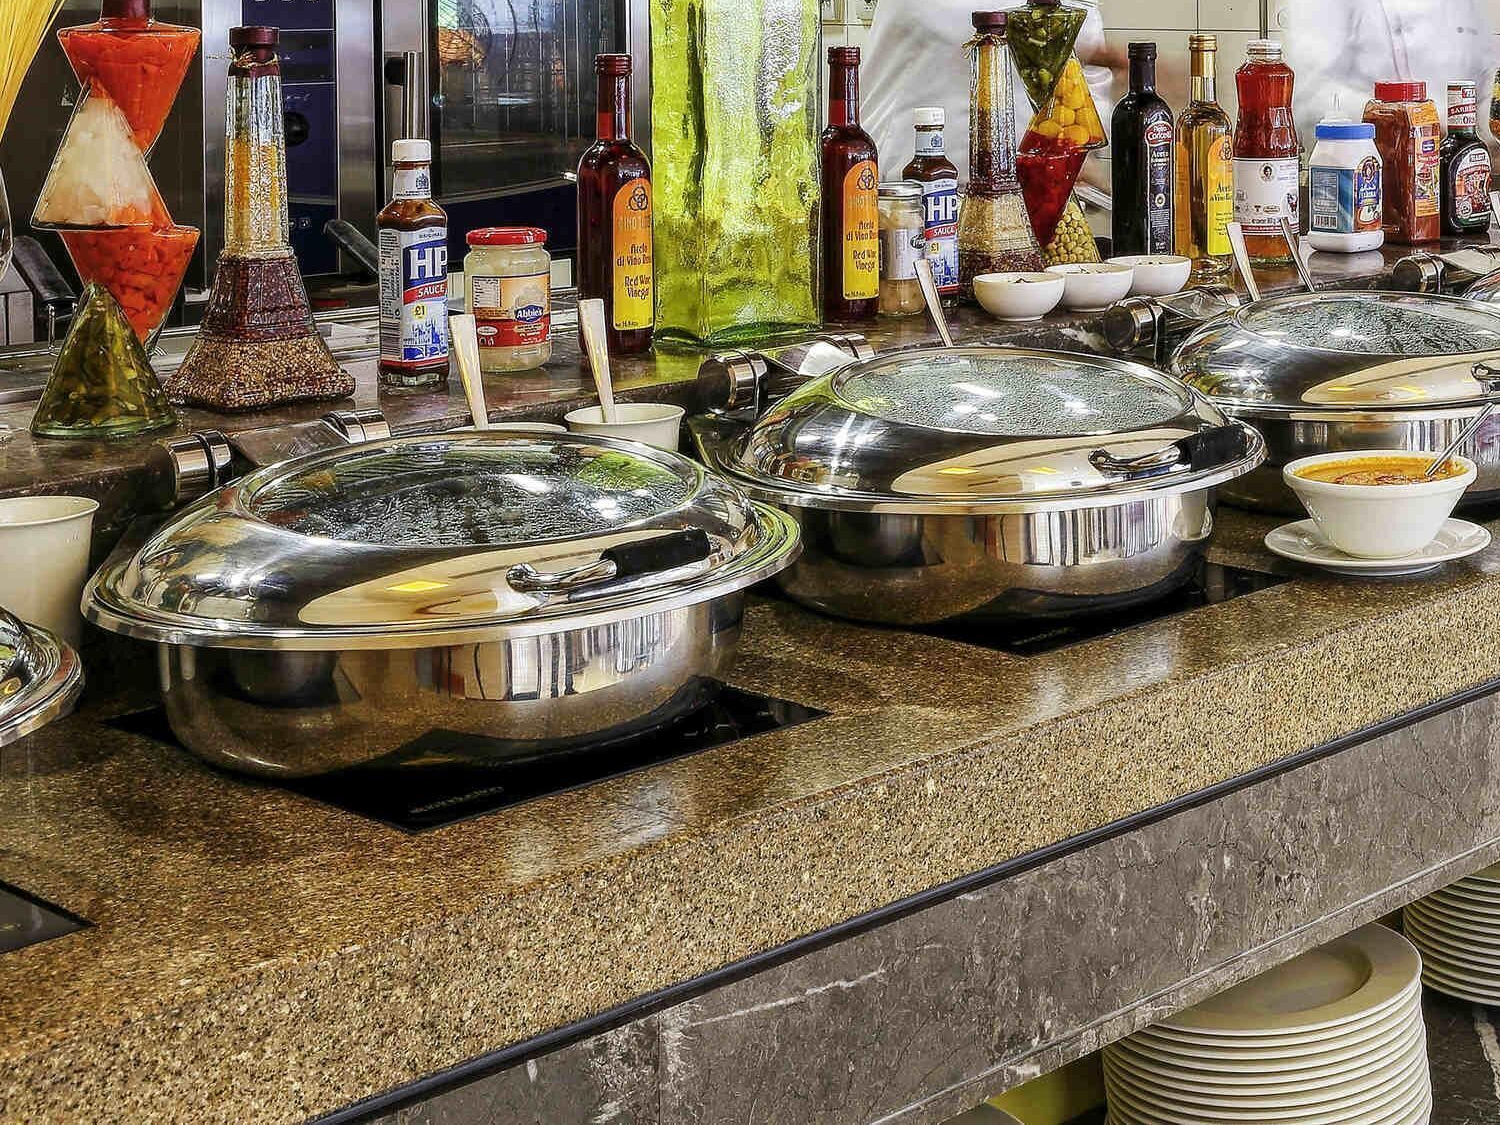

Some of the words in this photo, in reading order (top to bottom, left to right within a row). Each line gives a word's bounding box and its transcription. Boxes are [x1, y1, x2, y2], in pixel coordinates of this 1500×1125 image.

[927, 195, 959, 222] HP
[933, 225, 956, 237] SAUCE
[930, 242, 940, 252] £1
[410, 246, 448, 281] HP
[625, 275, 638, 287] Red
[418, 283, 445, 297] SAUCE
[415, 305, 425, 316] £1
[516, 307, 543, 319] Abbie's
